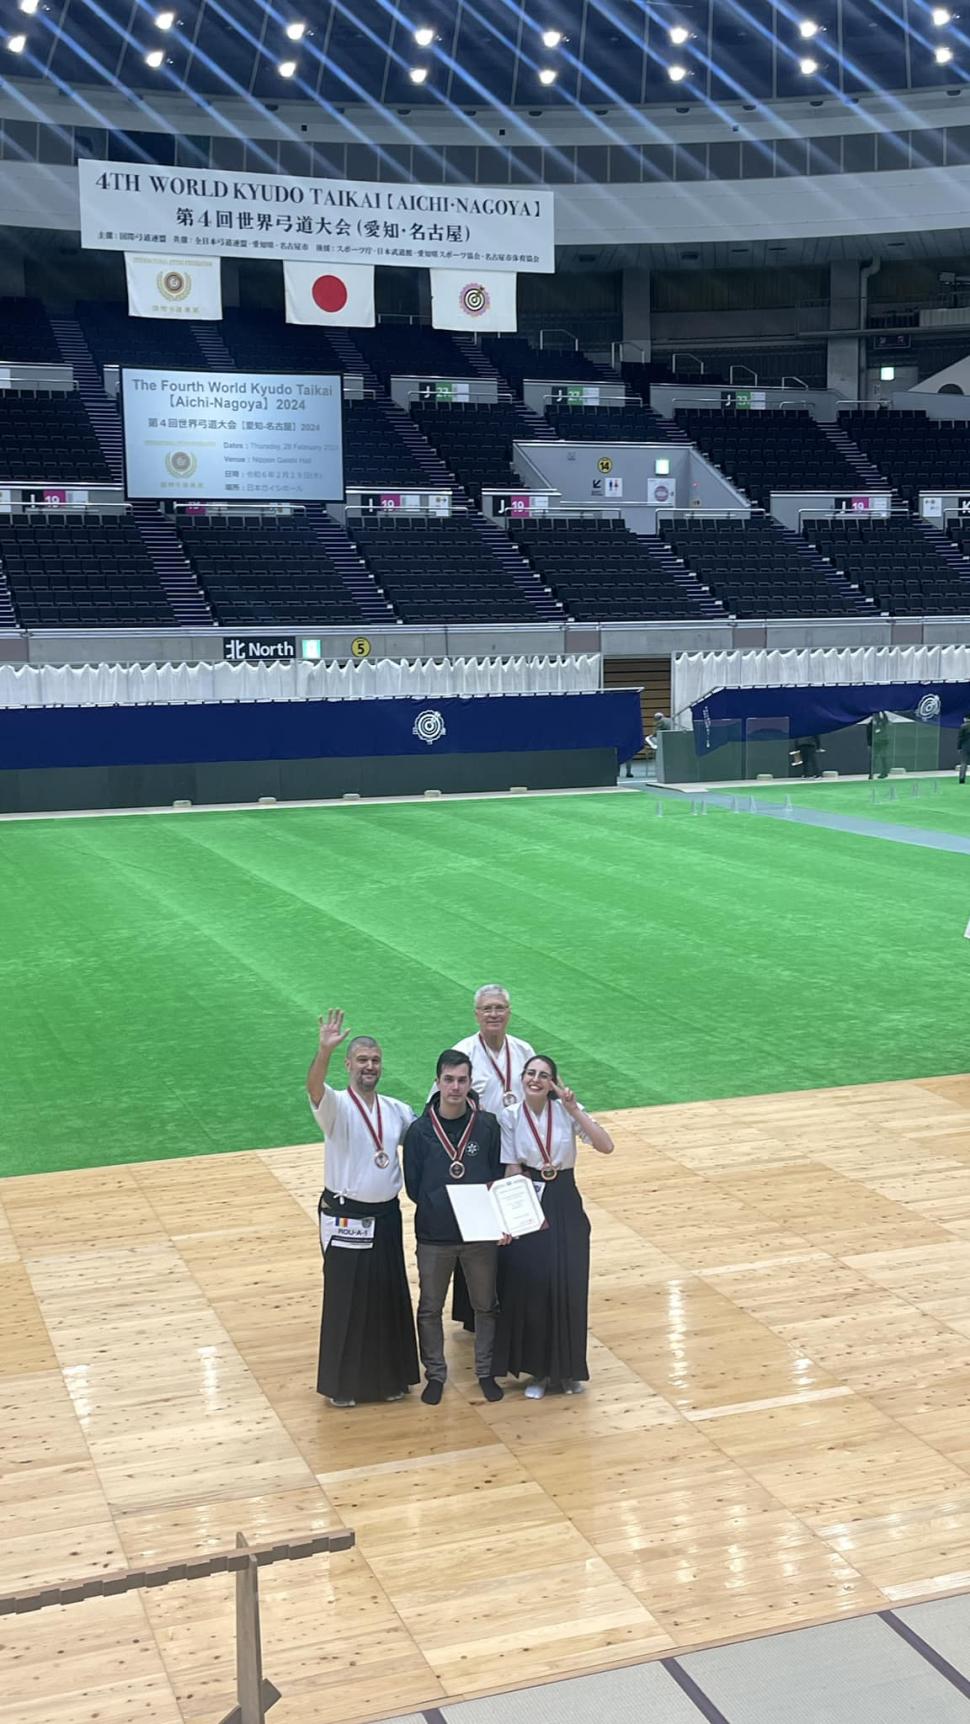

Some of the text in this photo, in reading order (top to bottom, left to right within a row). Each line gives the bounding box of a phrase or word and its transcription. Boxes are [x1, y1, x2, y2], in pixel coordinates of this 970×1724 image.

[96, 172, 141, 192] 4TH
[149, 175, 228, 198] WORLD
[233, 182, 304, 204] KYUDO
[309, 188, 380, 209] TAIKAI
[132, 379, 333, 397] The Fourth World Kyudo Taikai
[276, 399, 306, 410] 2024
[600, 461, 609, 470] 14
[45, 496, 60, 508] 19
[382, 499, 395, 512] 19
[498, 499, 524, 513] J 19
[852, 502, 865, 513] 19
[225, 639, 294, 659] 北 North
[358, 643, 365, 655] 5
